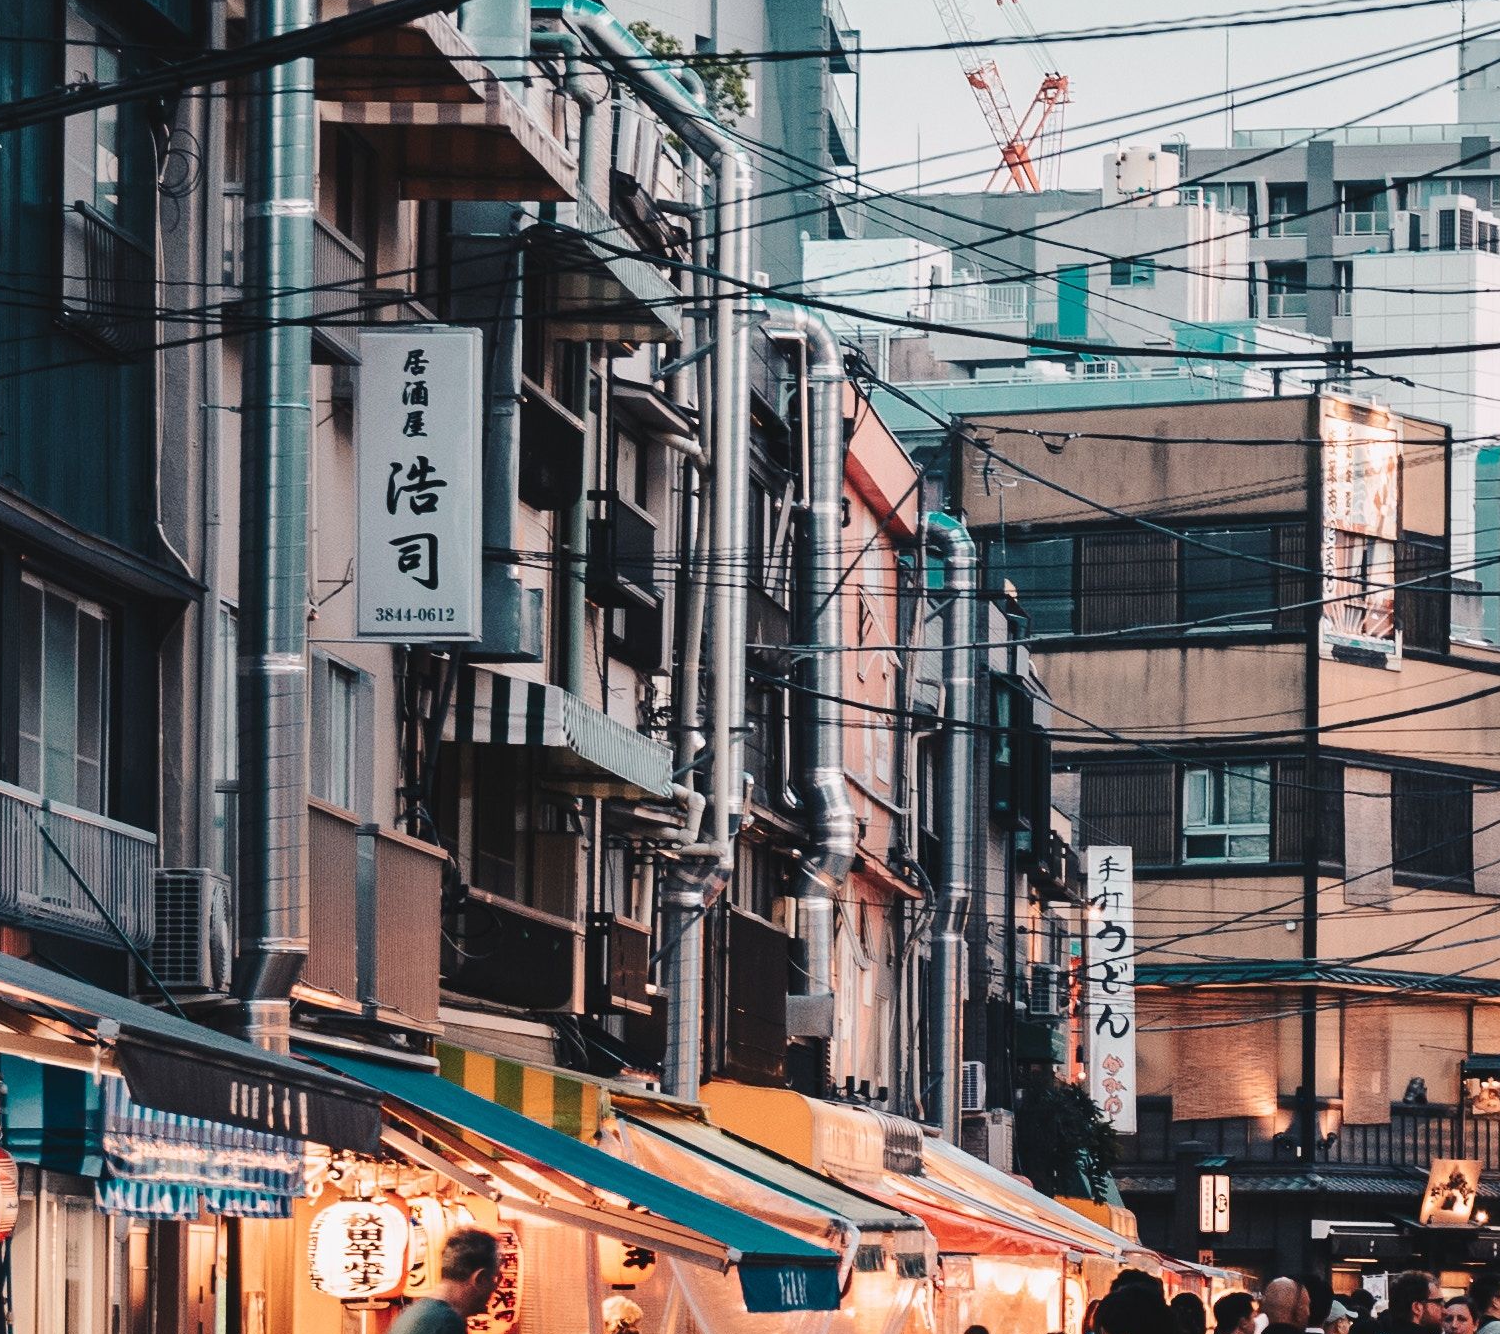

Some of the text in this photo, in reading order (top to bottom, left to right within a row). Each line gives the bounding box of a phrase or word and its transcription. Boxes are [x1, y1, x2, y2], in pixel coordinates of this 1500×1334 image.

[402, 349, 430, 438] 居酒屋
[386, 455, 448, 591] 浩司
[375, 607, 456, 623] 3844-0612
